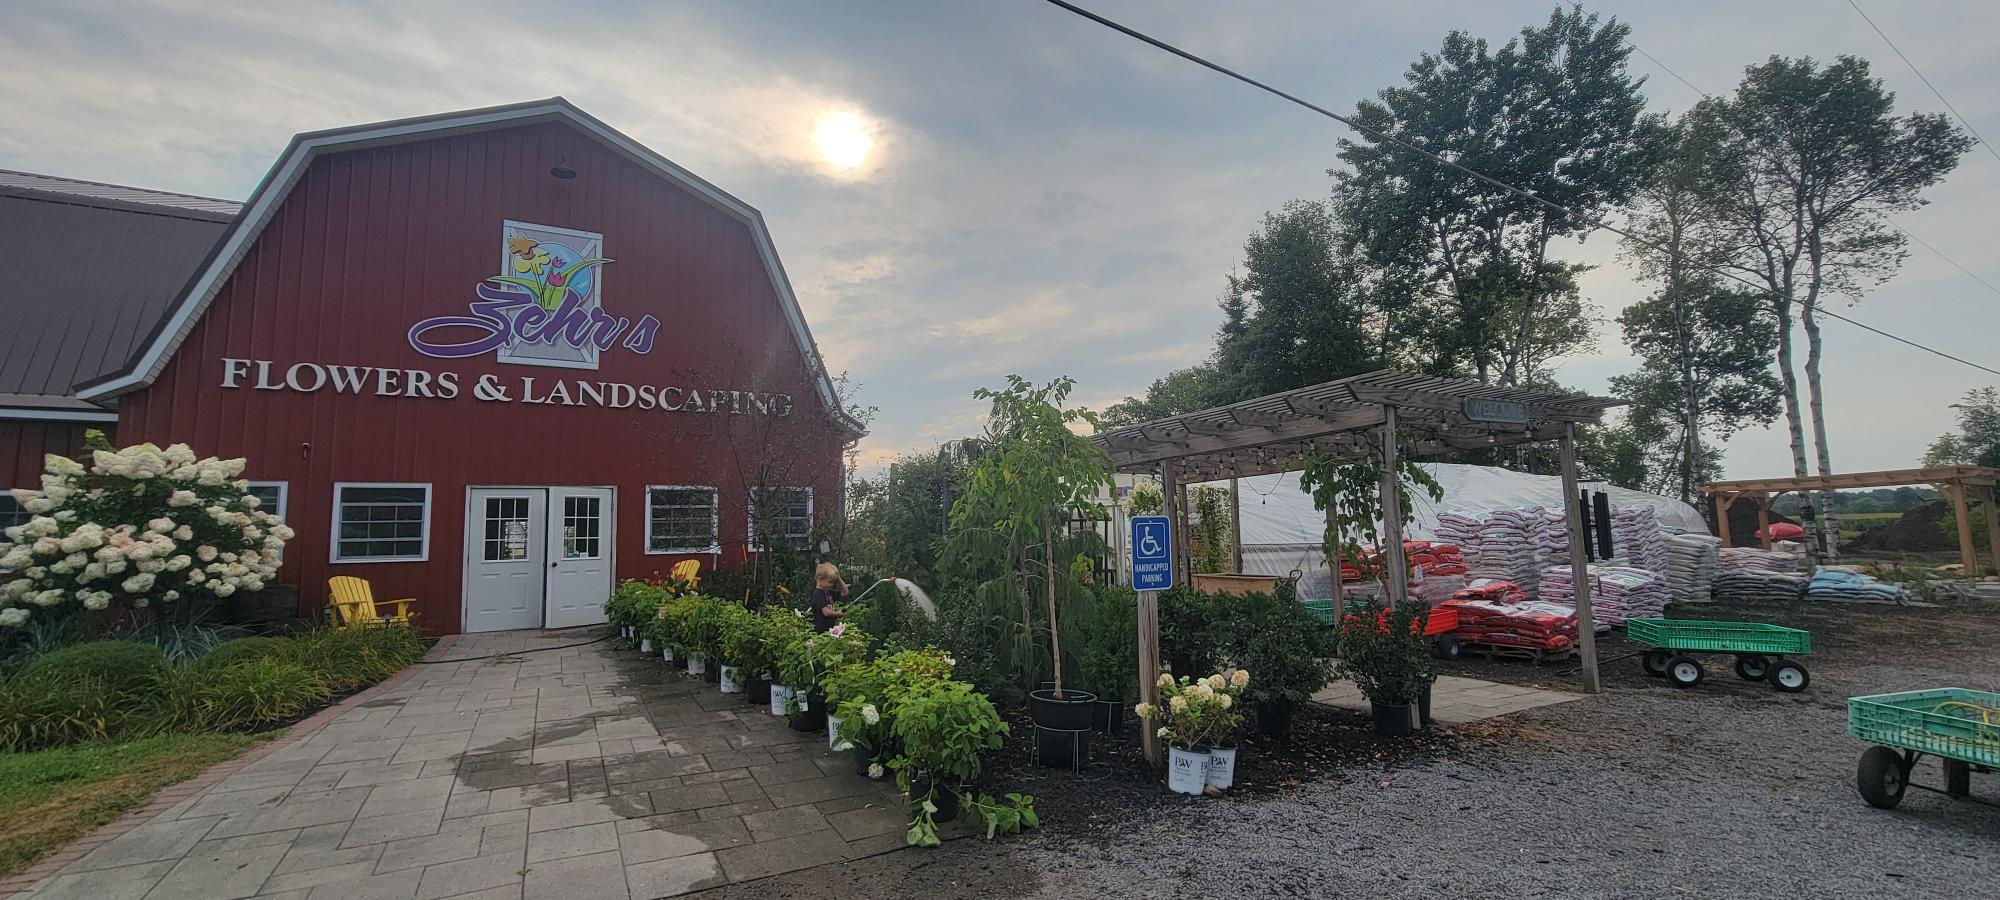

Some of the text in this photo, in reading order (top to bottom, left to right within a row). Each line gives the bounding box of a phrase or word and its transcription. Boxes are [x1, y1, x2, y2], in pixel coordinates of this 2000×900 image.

[219, 357, 793, 418] FLOWERS & LANDSCAPING
[1470, 400, 1527, 418] WELCOME
[1134, 562, 1169, 573] HANDICAPPED
[1141, 573, 1163, 583] PARKING
